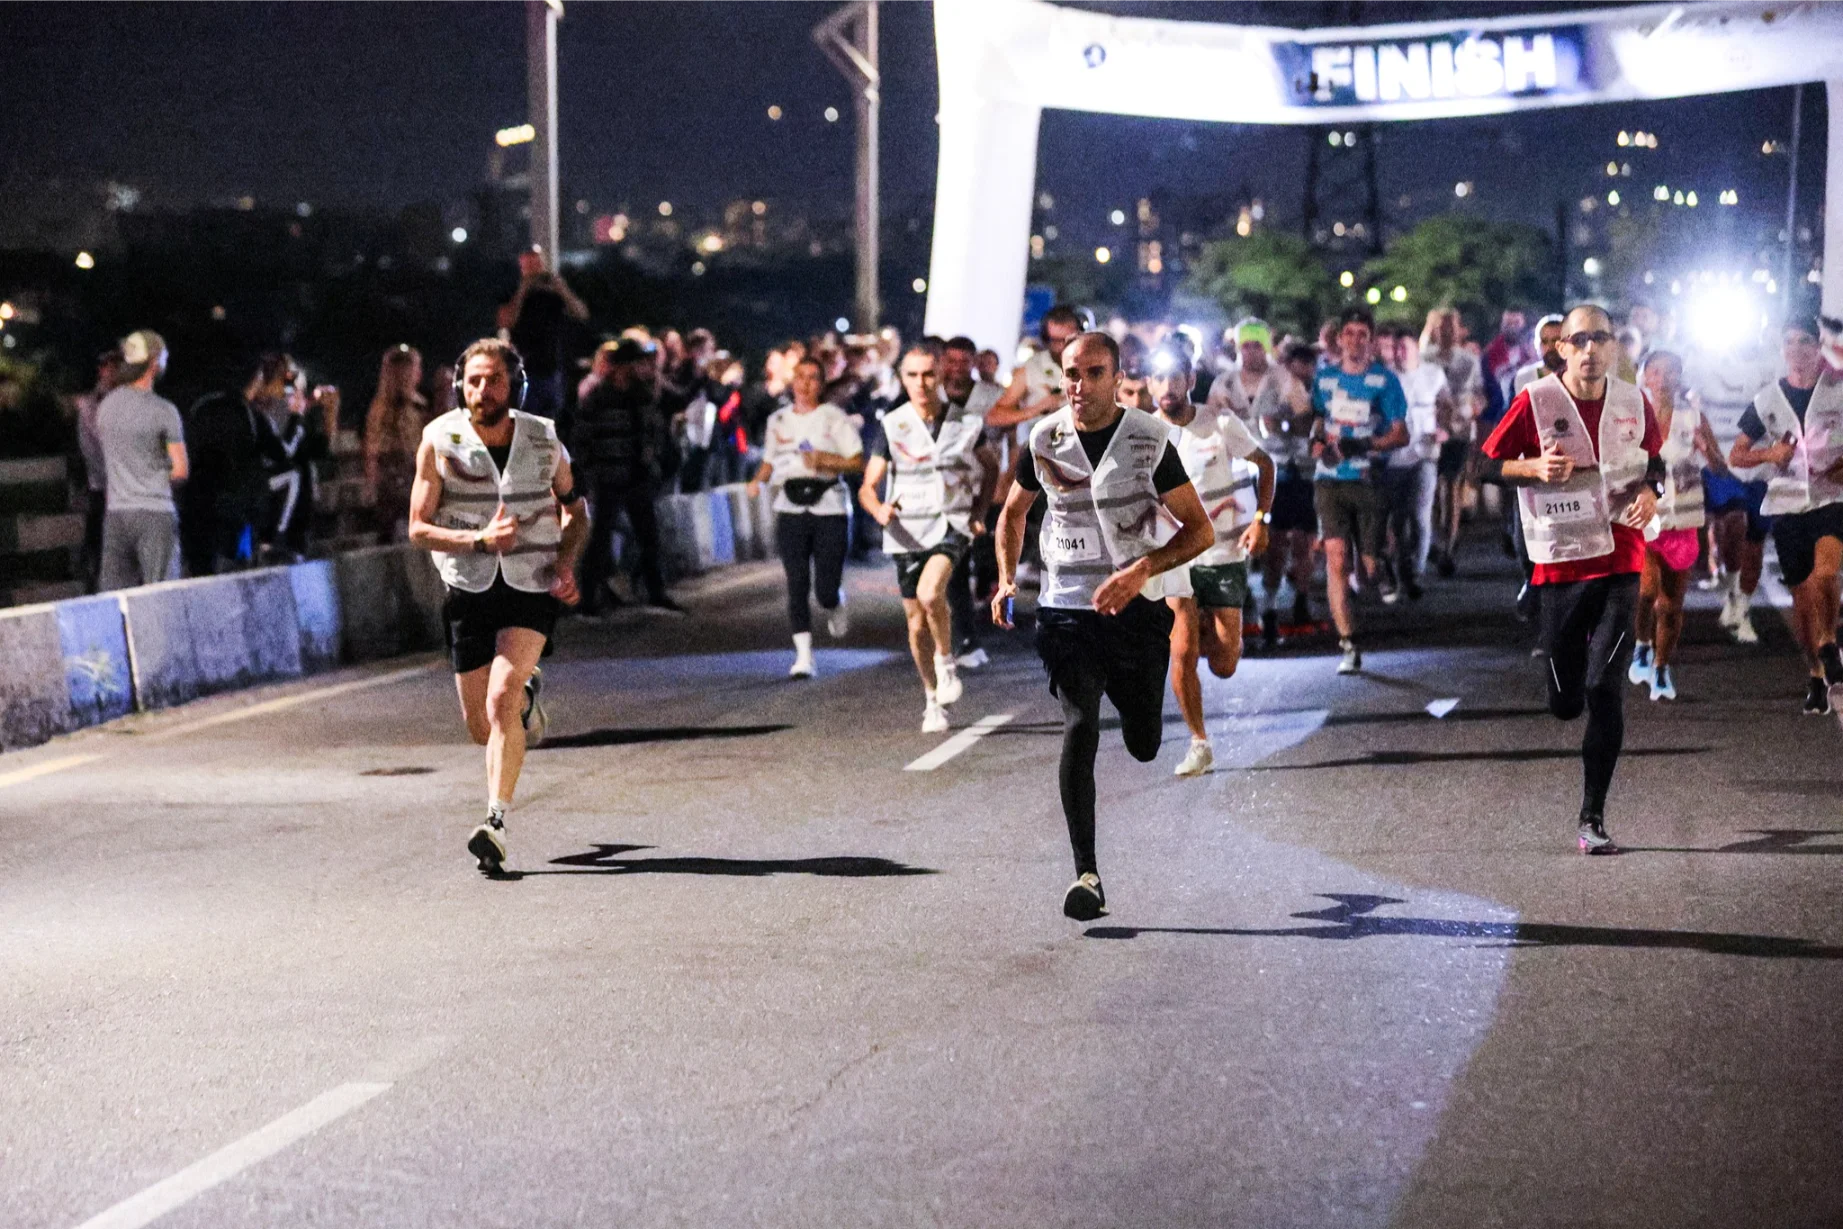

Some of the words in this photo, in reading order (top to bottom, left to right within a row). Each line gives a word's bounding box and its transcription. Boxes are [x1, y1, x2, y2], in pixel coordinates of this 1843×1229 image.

[1311, 34, 1556, 101] FINISH
[1546, 500, 1581, 515] 21118
[1056, 537, 1085, 550] 21041
